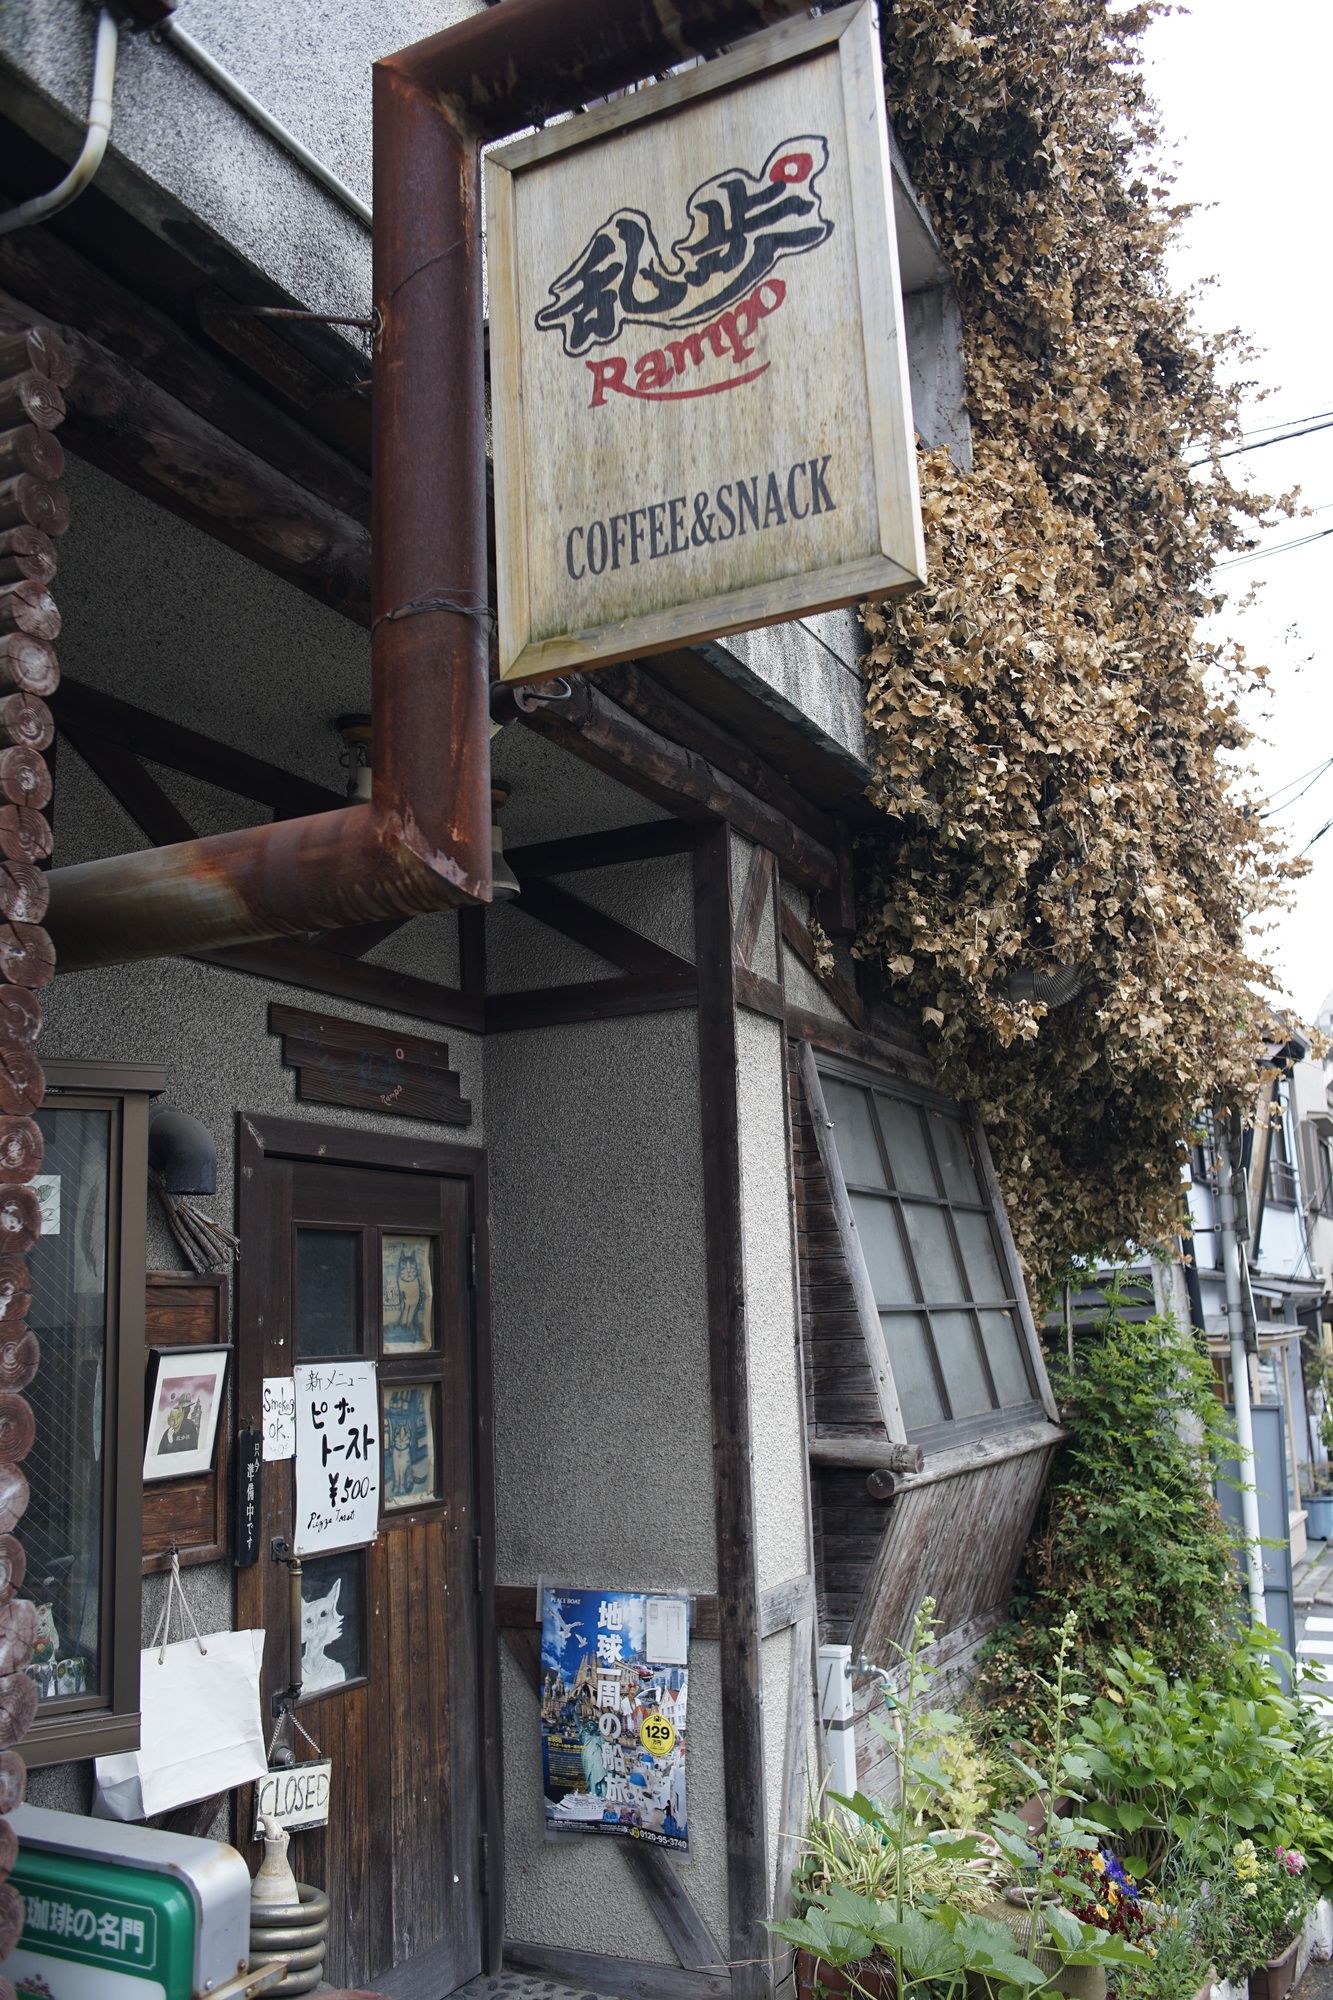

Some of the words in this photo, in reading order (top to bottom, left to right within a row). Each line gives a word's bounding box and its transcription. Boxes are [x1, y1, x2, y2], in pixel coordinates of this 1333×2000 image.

[585, 278, 787, 408] Rampo
[567, 455, 836, 581] COFFEE&SNACK
[379, 1084, 404, 1106] Rampo
[263, 1387, 295, 1416] Smoking
[305, 1369, 368, 1391] 新メニュー
[311, 1397, 355, 1430] ピザ
[322, 1424, 375, 1467] トースト
[597, 1600, 627, 1801] 地球一周の船旅
[645, 1725, 670, 1740] 129
[260, 1773, 331, 1818] CLOSED
[26, 1895, 145, 1954] 珈琲の名門
